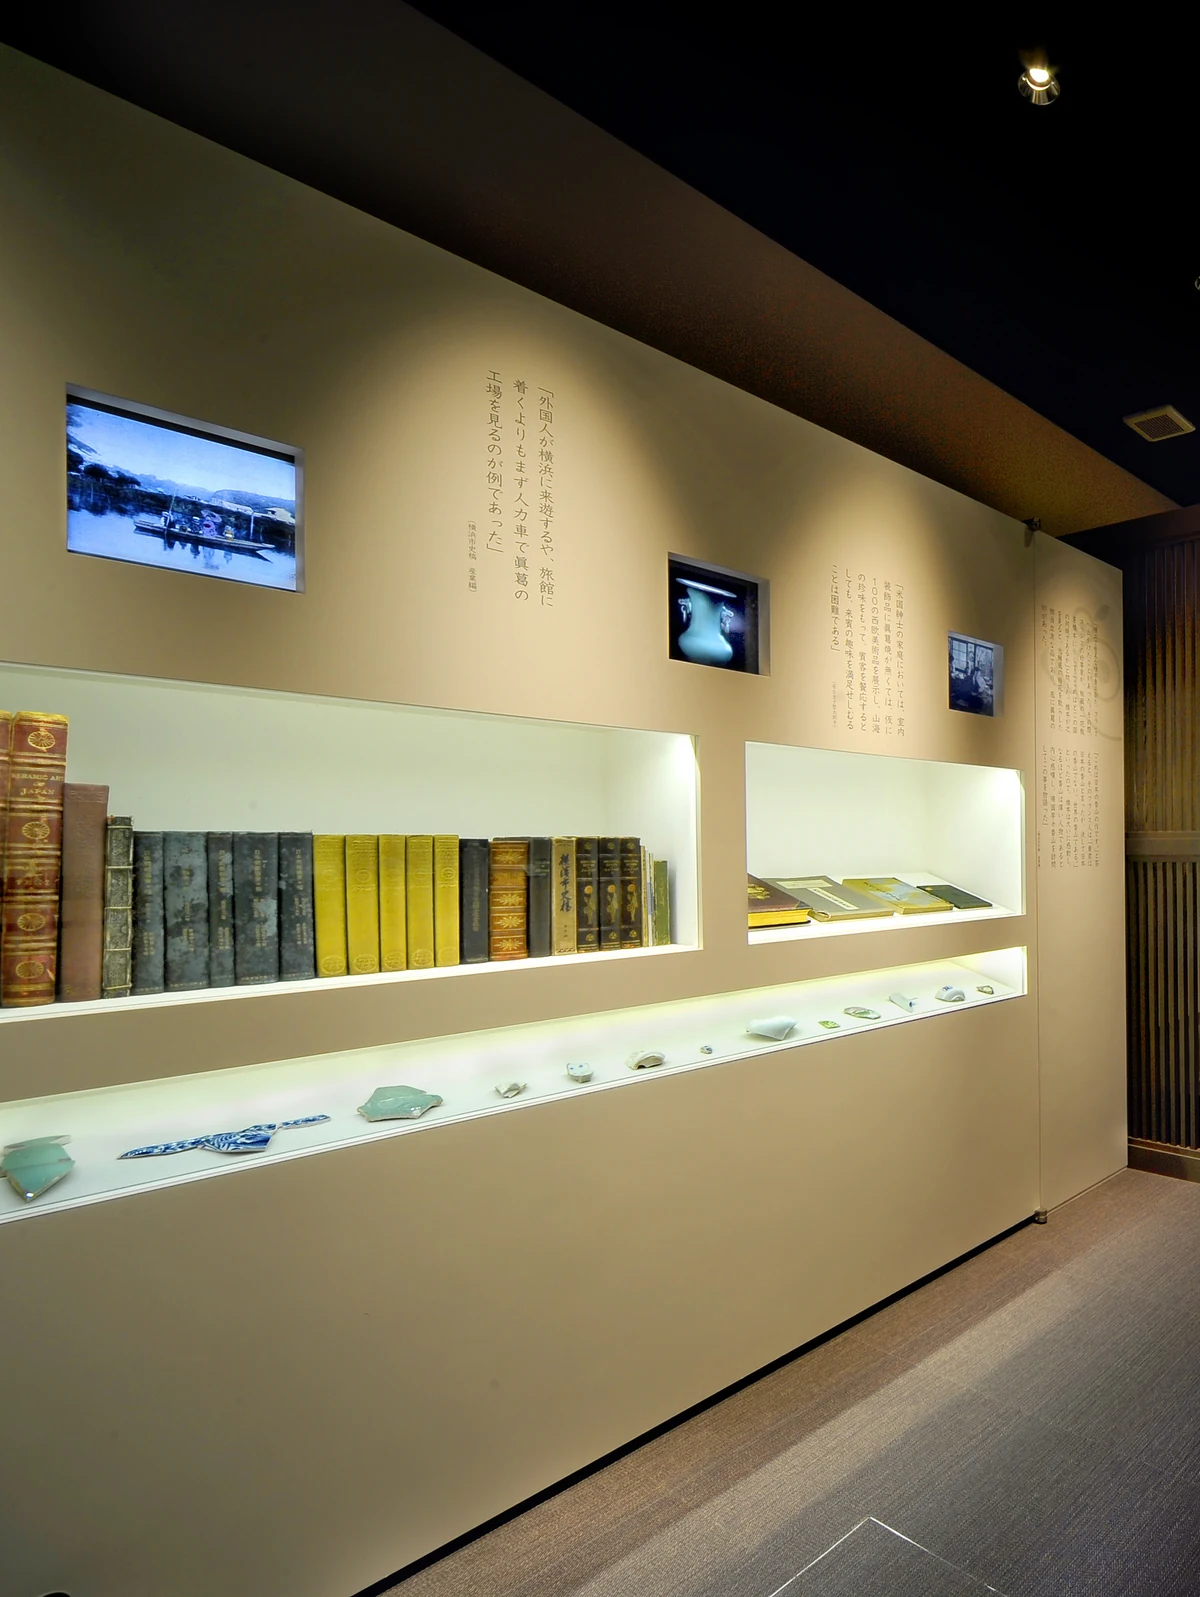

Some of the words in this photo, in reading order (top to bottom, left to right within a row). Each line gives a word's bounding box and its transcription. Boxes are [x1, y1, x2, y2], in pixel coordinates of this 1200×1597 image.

[486, 369, 504, 553] 工場を見るのが例であった」
[537, 386, 555, 607] 「外国人が横浜に来遊するや、旅館に
[830, 564, 841, 652] ことは困難である」
